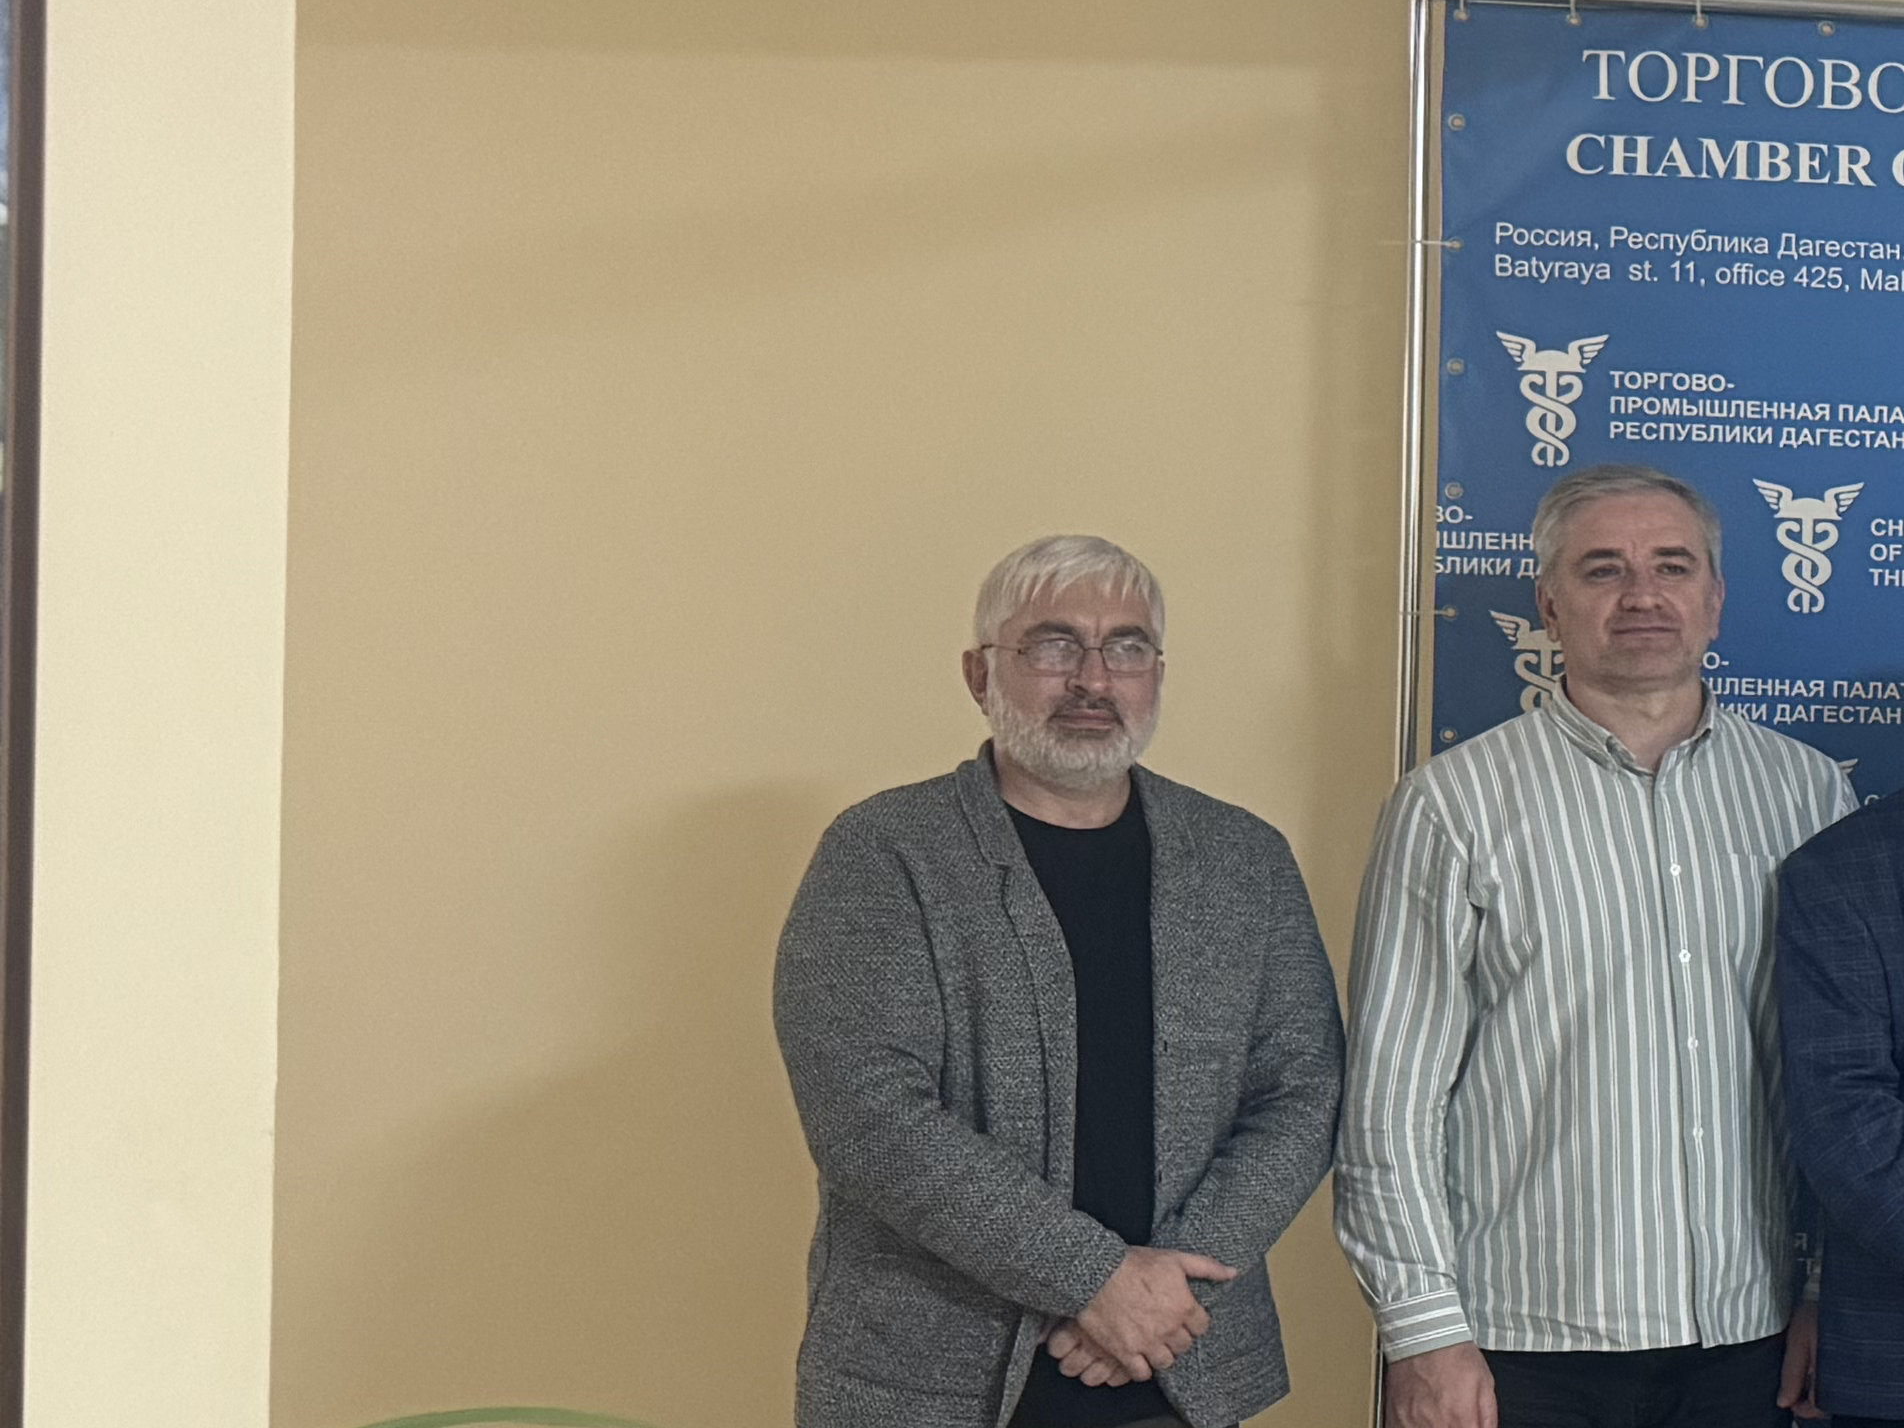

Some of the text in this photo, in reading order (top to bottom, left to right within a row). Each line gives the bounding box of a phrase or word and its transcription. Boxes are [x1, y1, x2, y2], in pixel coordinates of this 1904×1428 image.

[1566, 132, 1877, 187] CHAMBER
[1494, 222, 1600, 251] Россия,
[1609, 226, 1769, 256] Республика
[1494, 253, 1611, 286] Batyraya
[1628, 260, 1658, 282] st.
[1670, 260, 1706, 287] 11,
[1714, 262, 1786, 287] office
[1792, 265, 1850, 293] 425,
[1608, 370, 1736, 392] ТОРГОВО-
[1609, 395, 1831, 422] ПРОМЫШЛЕННАЯ
[1609, 420, 1774, 445] РЕСПУБЛИКИ
[1869, 544, 1902, 562] OF
[1772, 703, 1902, 726] ДАГЕСТАН
